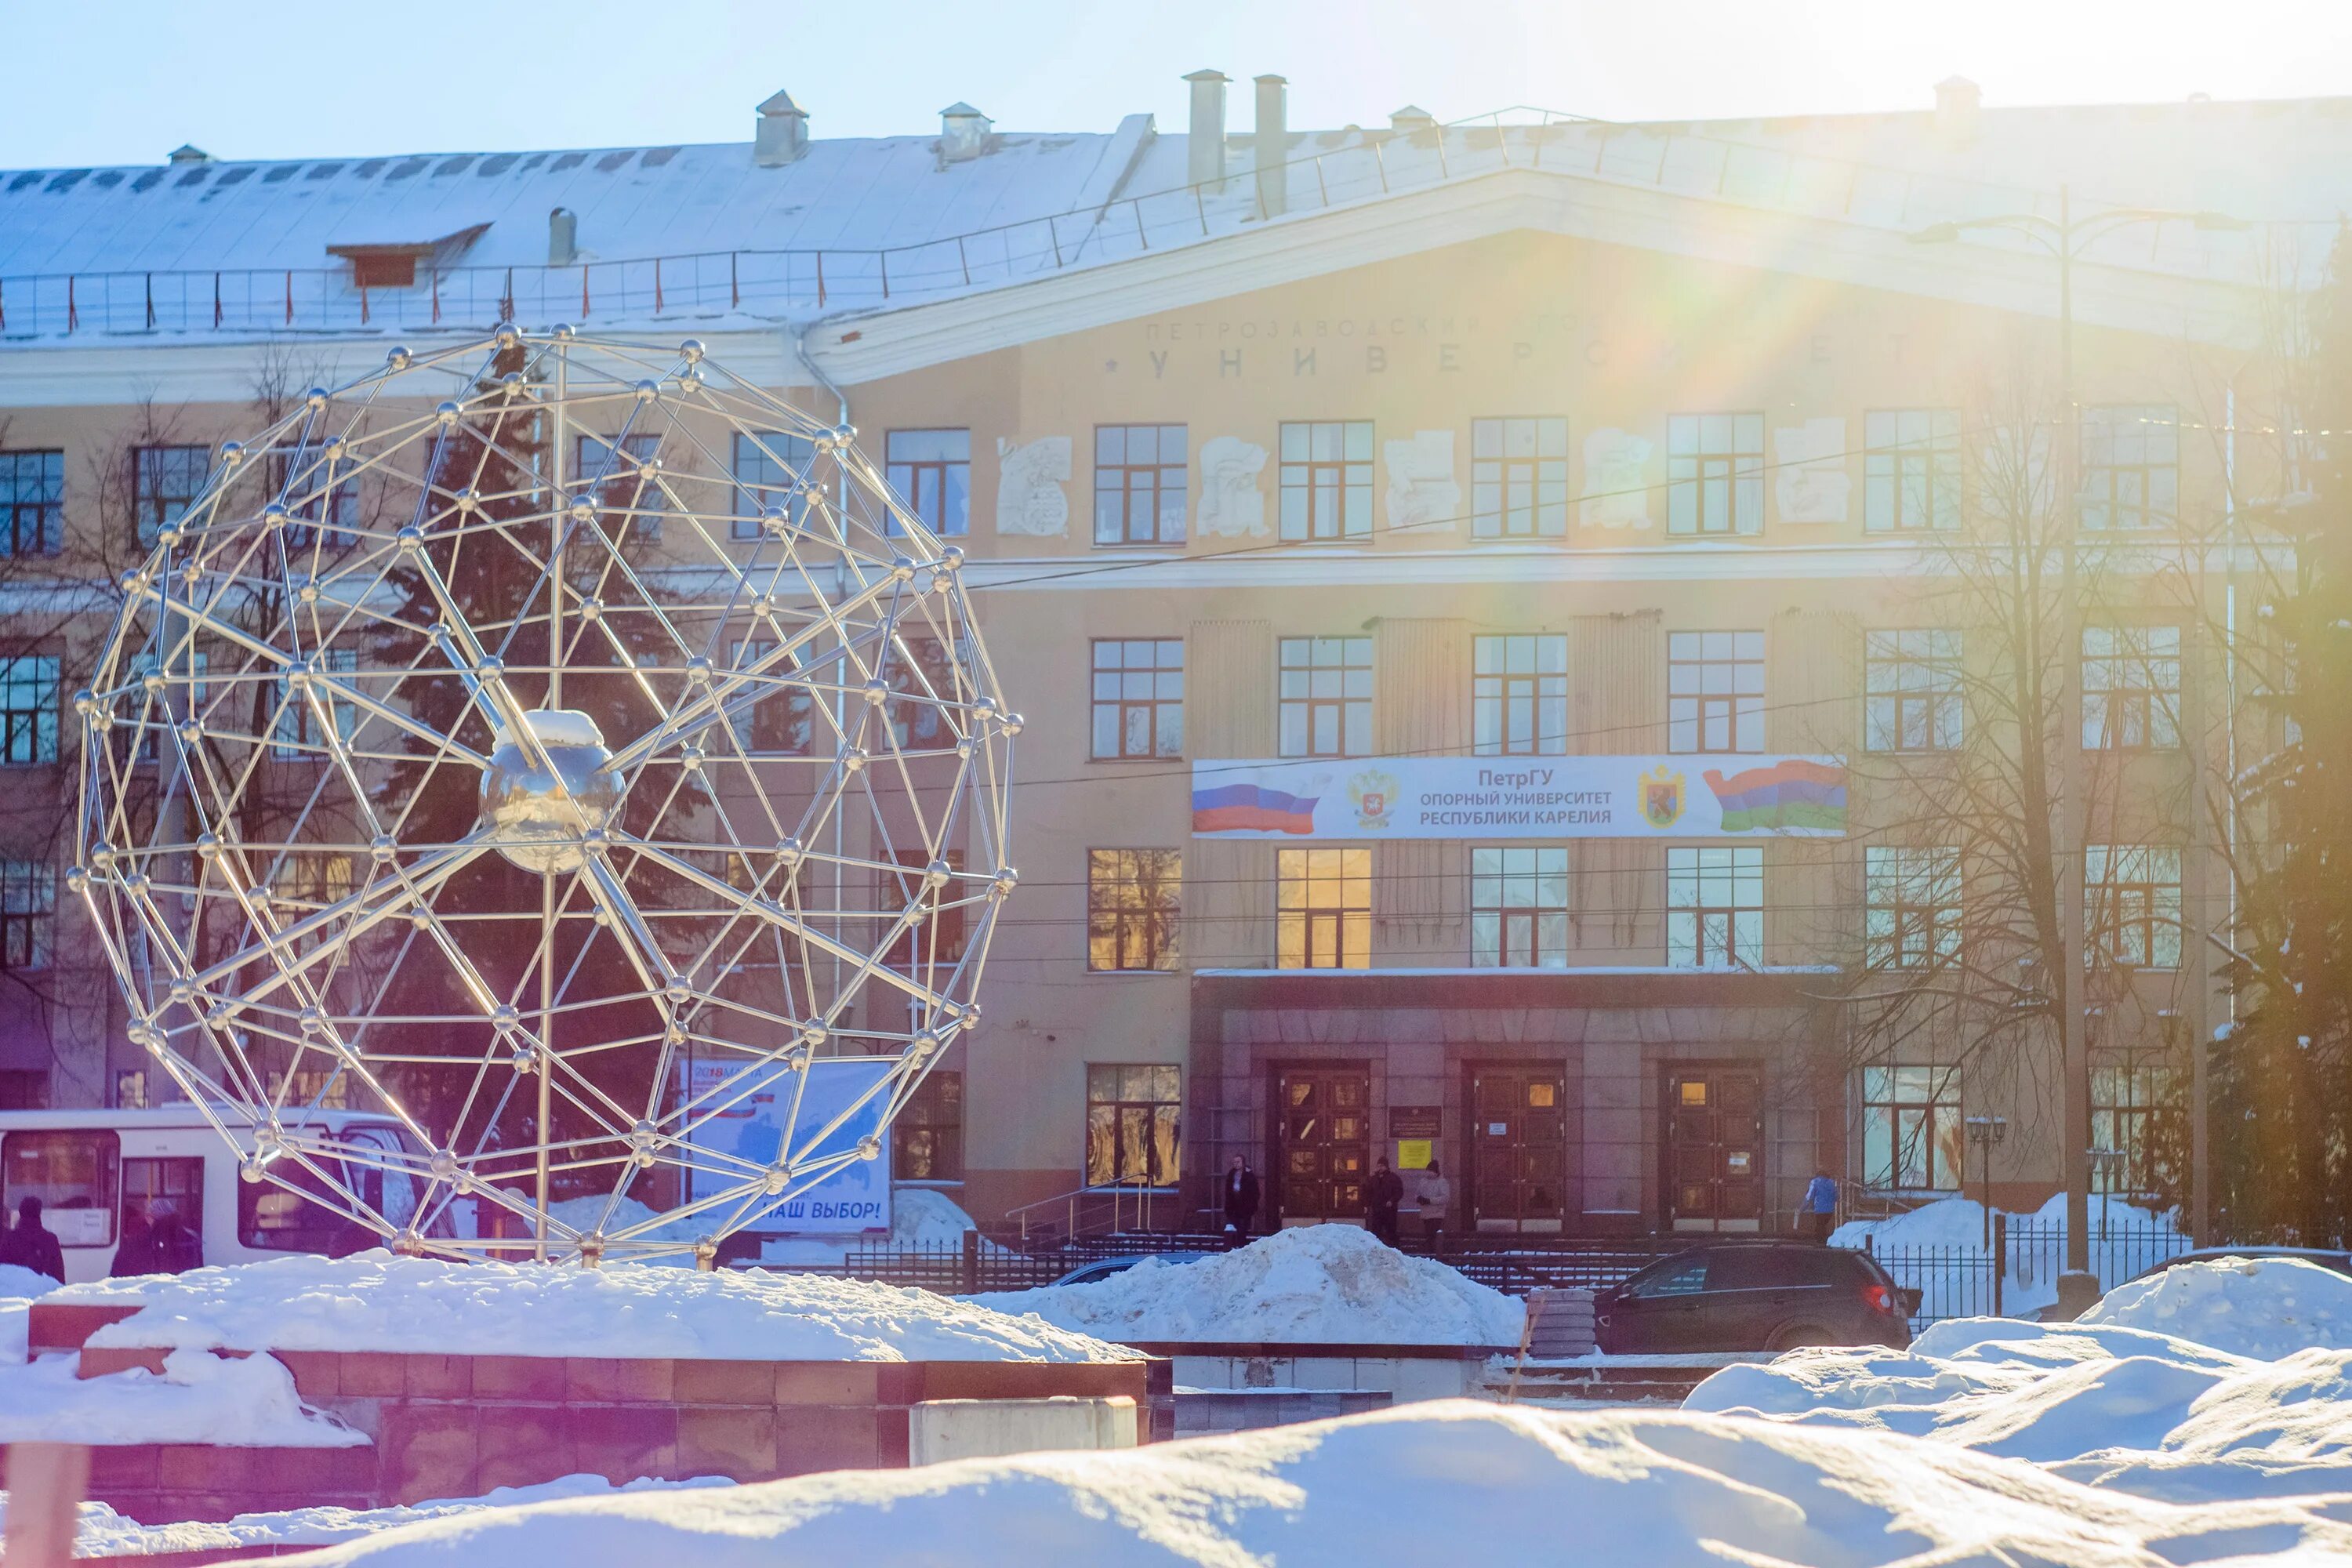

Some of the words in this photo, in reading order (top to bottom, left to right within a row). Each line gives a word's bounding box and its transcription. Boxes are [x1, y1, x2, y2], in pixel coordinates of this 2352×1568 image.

[1479, 769, 1554, 789] ПетрГУ
[1420, 791, 1500, 806] ОПОРНЫЙ
[1504, 792, 1612, 805] УНИВЕРСИТЕТ
[1420, 811, 1530, 825] РЕСПУБЛИКИ
[1534, 810, 1611, 824] КАРЕЛИЯ
[811, 1202, 881, 1218] ВЫБОР!
